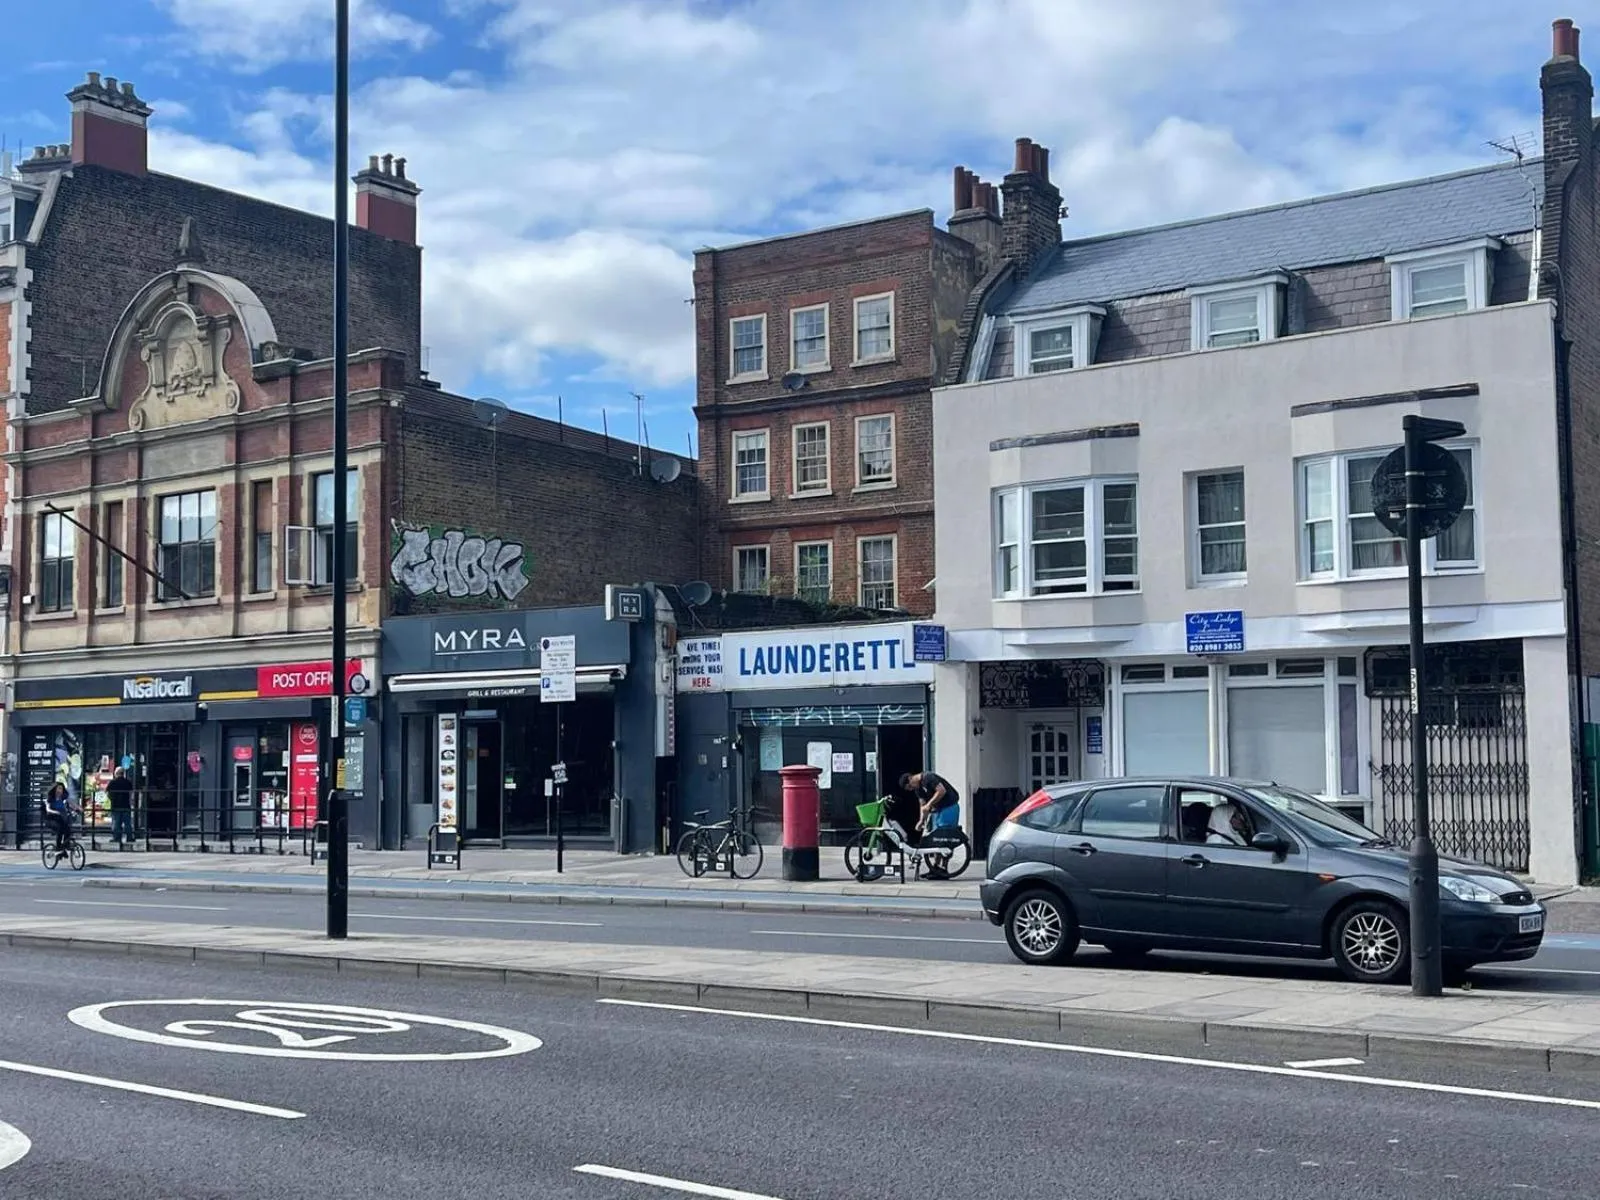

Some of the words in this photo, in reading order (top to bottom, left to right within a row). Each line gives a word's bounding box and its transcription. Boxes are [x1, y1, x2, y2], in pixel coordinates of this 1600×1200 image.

[434, 628, 526, 652] MYRA
[679, 666, 705, 675] SERVICE
[272, 673, 302, 688] POST
[304, 671, 333, 687] OFFI
[692, 677, 711, 687] HERE
[490, 688, 526, 696] RESTAURANT
[164, 1007, 411, 1048] 20
